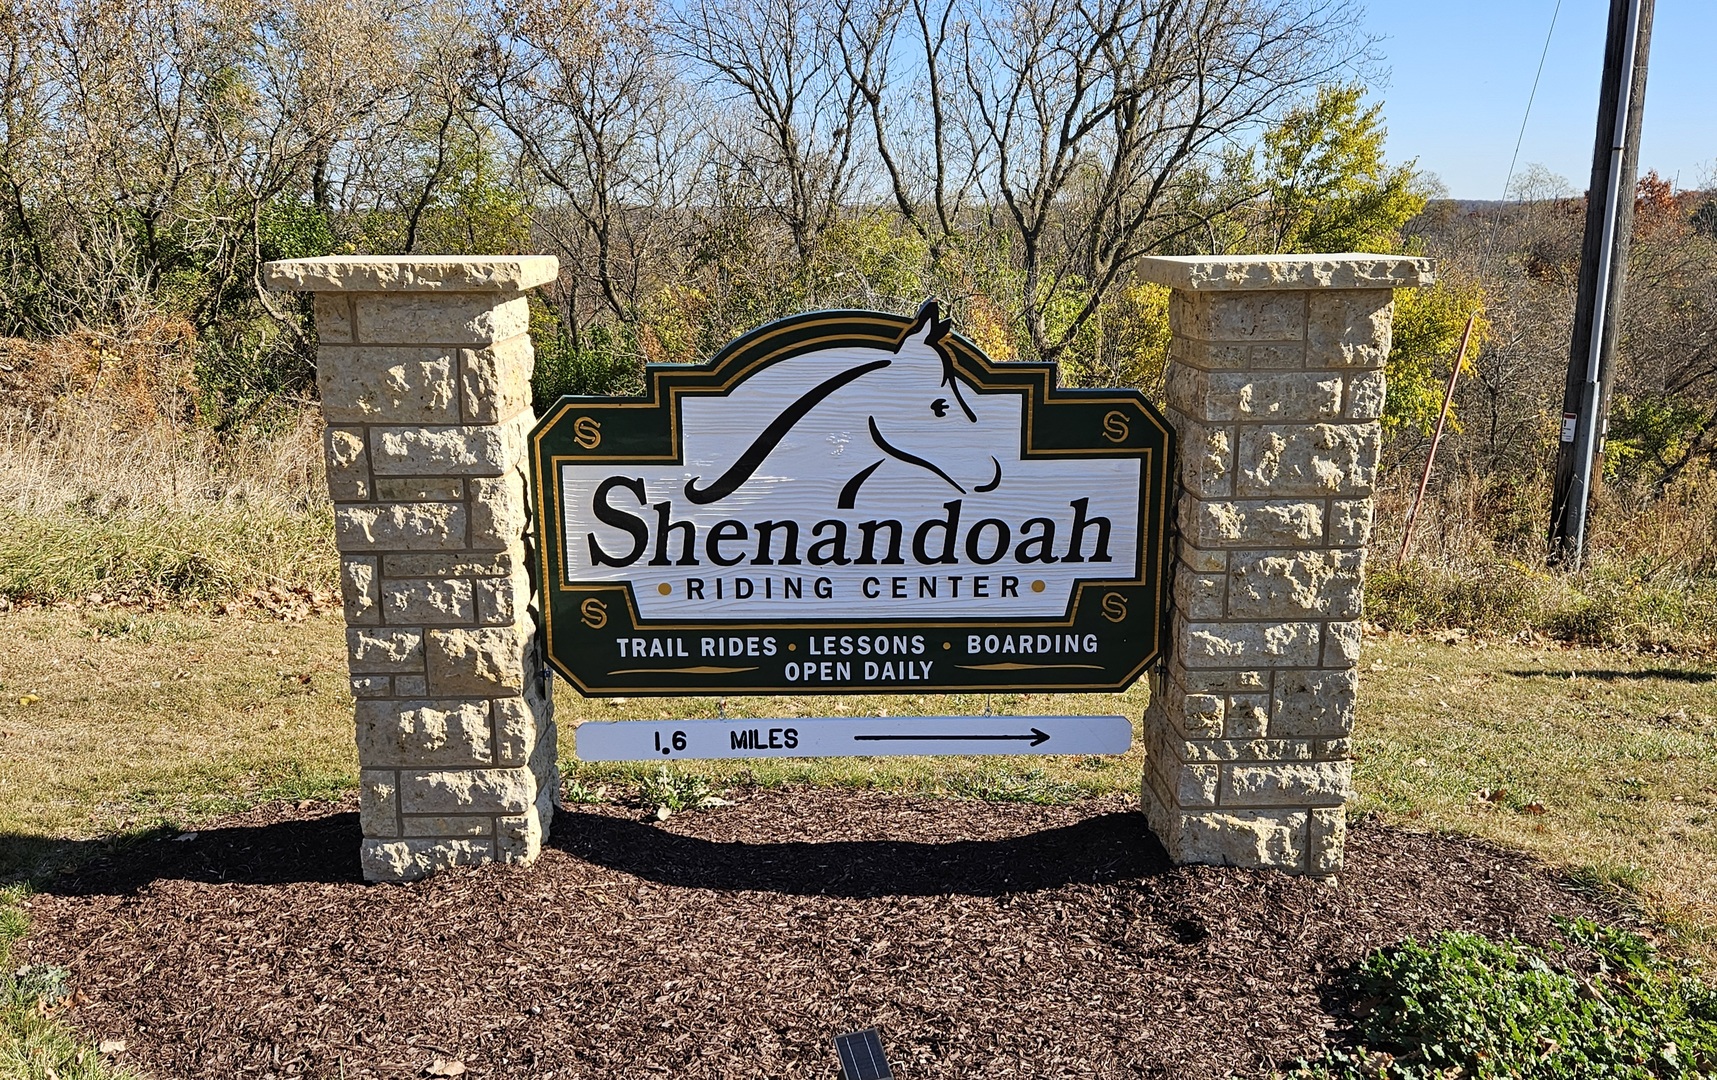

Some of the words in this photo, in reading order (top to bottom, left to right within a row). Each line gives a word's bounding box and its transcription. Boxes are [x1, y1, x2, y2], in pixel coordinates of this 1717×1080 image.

[574, 416, 601, 449] S
[1102, 410, 1130, 443] S
[587, 475, 1113, 568] Shenandoah
[686, 577, 833, 600] RIDING
[862, 575, 1020, 599] CENTER
[580, 597, 608, 629] S
[1101, 591, 1128, 623] S
[616, 637, 689, 658] TRAIL
[701, 636, 777, 657] RIDES
[808, 635, 925, 656] LESSONS
[967, 633, 1098, 654] BOARDING
[784, 661, 851, 682] OPEN
[864, 660, 934, 681] DAILY
[654, 730, 688, 755] 1.6
[730, 728, 799, 750] MILES
